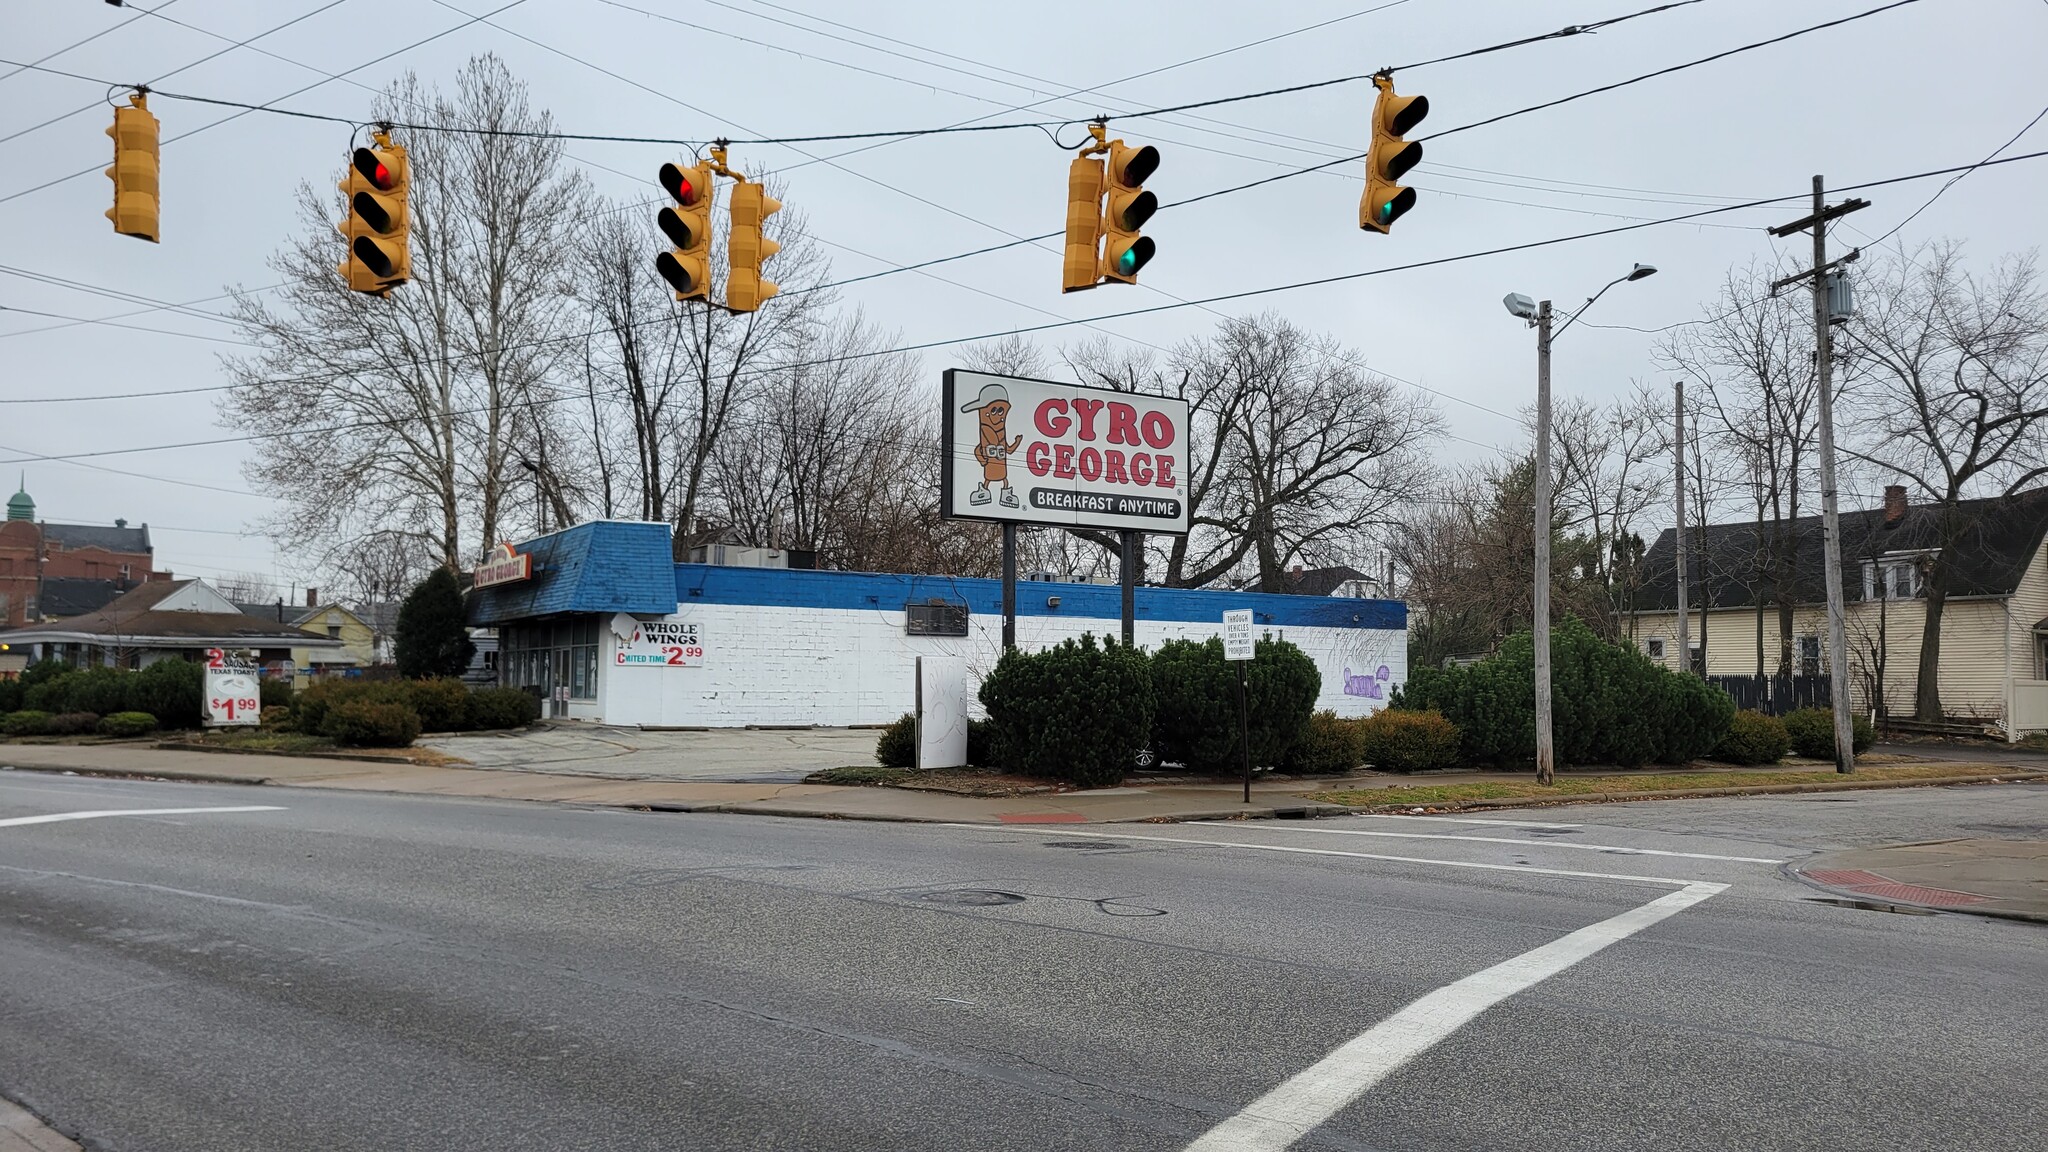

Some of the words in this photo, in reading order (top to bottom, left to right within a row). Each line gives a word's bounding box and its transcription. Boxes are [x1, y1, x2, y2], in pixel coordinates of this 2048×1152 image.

[1034, 398, 1175, 449] GYRO
[1026, 441, 1176, 489] GEORGE
[1037, 490, 1113, 511] BREAKFAST
[1118, 498, 1175, 516] ANYTIME
[1227, 615, 1249, 623] THROUGH
[642, 622, 698, 634] WHOLE
[1228, 624, 1249, 632] VEHICLES
[646, 634, 698, 645] WINGS
[1228, 646, 1251, 655] PROHIBITED
[648, 655, 667, 663] TIME
